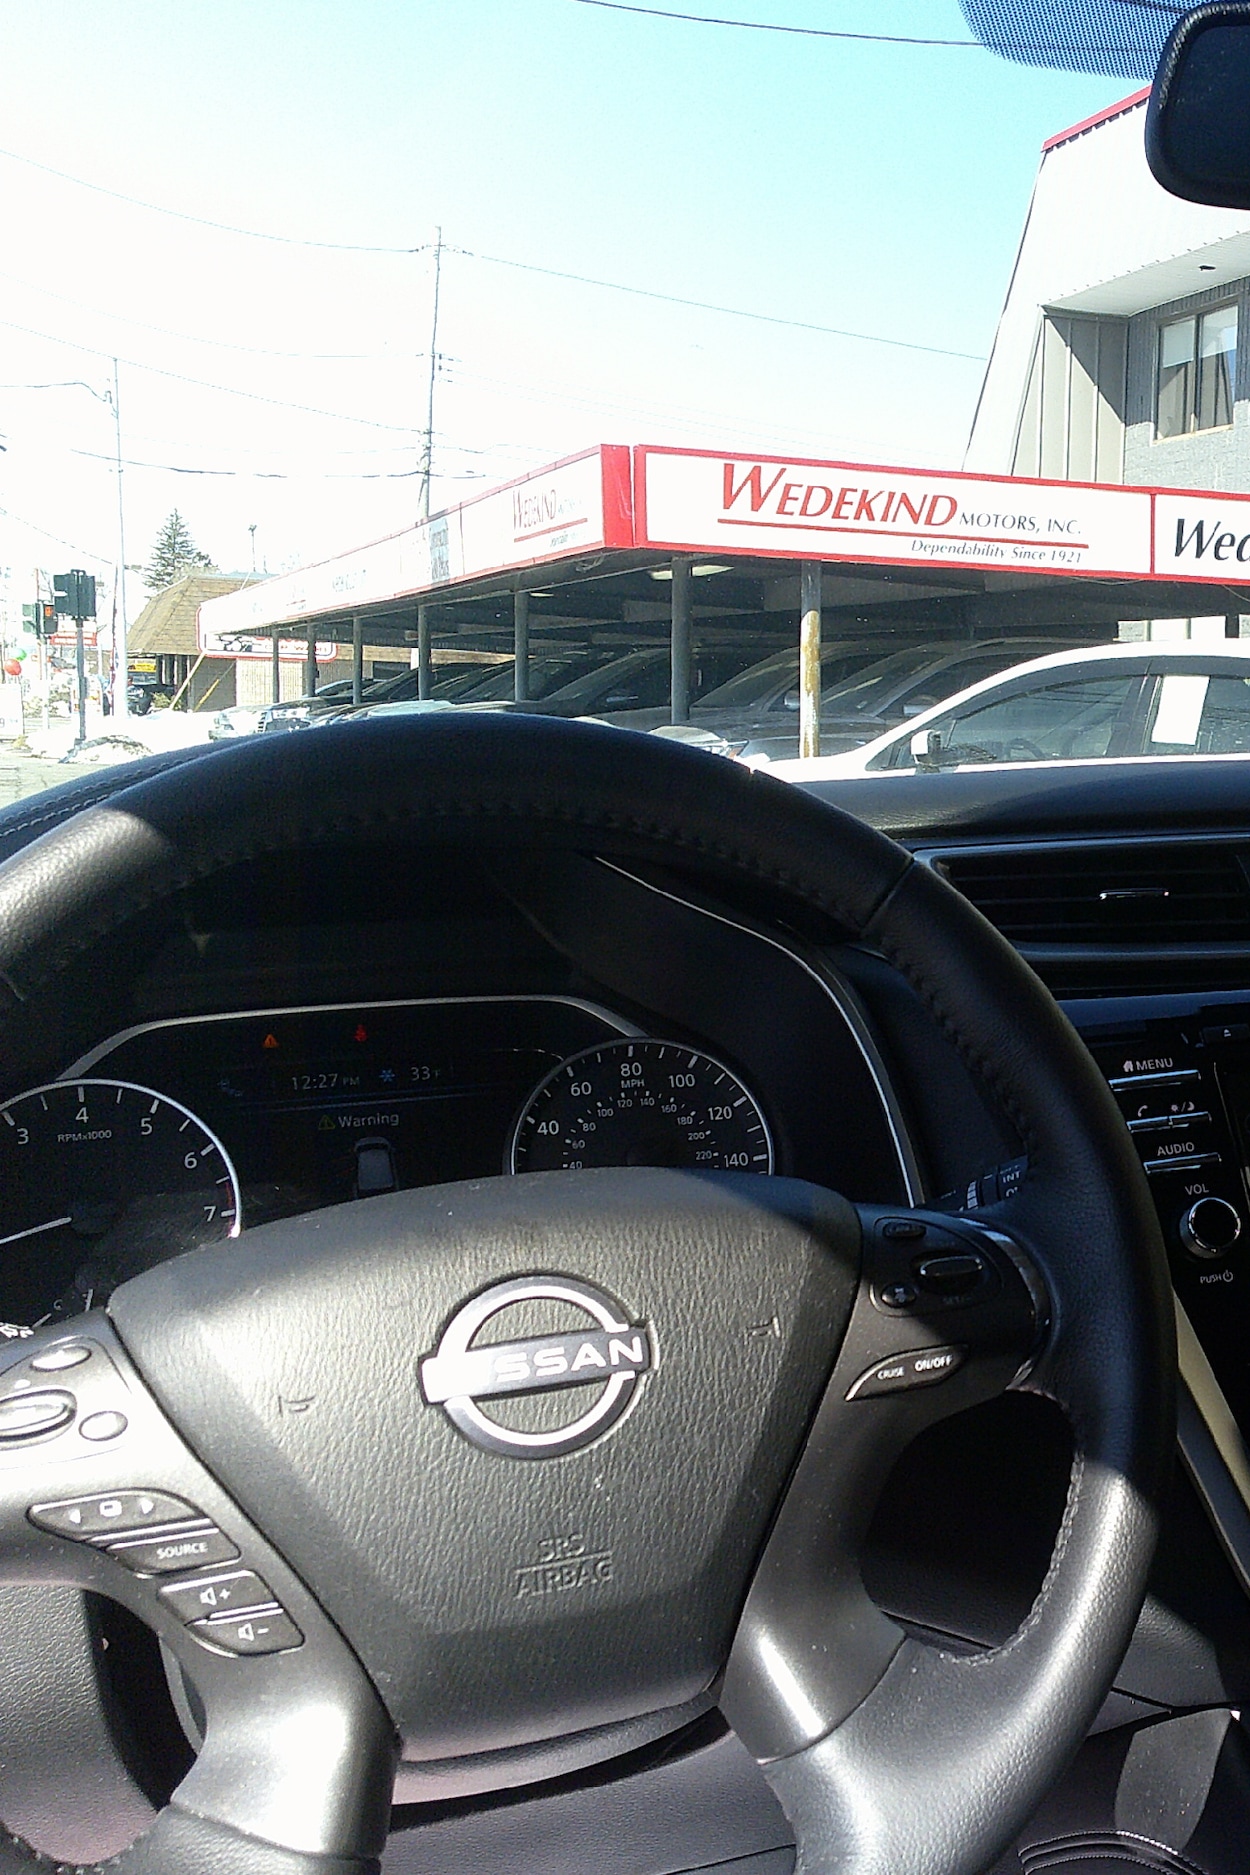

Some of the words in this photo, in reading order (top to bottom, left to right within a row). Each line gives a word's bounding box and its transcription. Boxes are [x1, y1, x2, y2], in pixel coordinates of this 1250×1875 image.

[722, 462, 958, 526] WEDEKIND
[959, 512, 1040, 533] MOTORS,
[1047, 518, 1081, 534] INC.
[911, 540, 1007, 558] Dependability
[1011, 547, 1046, 561] Since
[1051, 550, 1082, 563] 1921
[620, 1062, 642, 1077] 80
[1136, 1057, 1173, 1071] MENU
[292, 1073, 338, 1090] 12:27
[410, 1066, 431, 1081] 33
[668, 1074, 695, 1088] 100
[570, 1081, 592, 1097] 60
[620, 1078, 645, 1089] MPH
[617, 1098, 633, 1108] 120
[640, 1097, 655, 1107] 140
[661, 1103, 677, 1114] 160
[75, 1107, 89, 1123] 4
[338, 1112, 400, 1129] Warning
[597, 1107, 614, 1118] 100
[677, 1115, 693, 1125] 180
[708, 1105, 733, 1121] 120
[140, 1117, 152, 1136] 5
[537, 1120, 559, 1136] 40
[582, 1121, 596, 1132] 80
[17, 1128, 30, 1145] 3
[688, 1131, 705, 1140] 200
[572, 1139, 585, 1149] 60
[1157, 1141, 1195, 1157] AUDIO
[184, 1152, 198, 1169] 6
[695, 1150, 712, 1160] 220
[724, 1152, 749, 1168] 140
[1185, 1183, 1209, 1196] VOL
[204, 1205, 217, 1222] 7
[1200, 1273, 1223, 1284] PUSH
[877, 1366, 905, 1380] CRUISE
[914, 1354, 953, 1372] ON/OFF
[156, 1541, 208, 1559] SOURCE
[514, 1558, 613, 1599] AIRBAG
